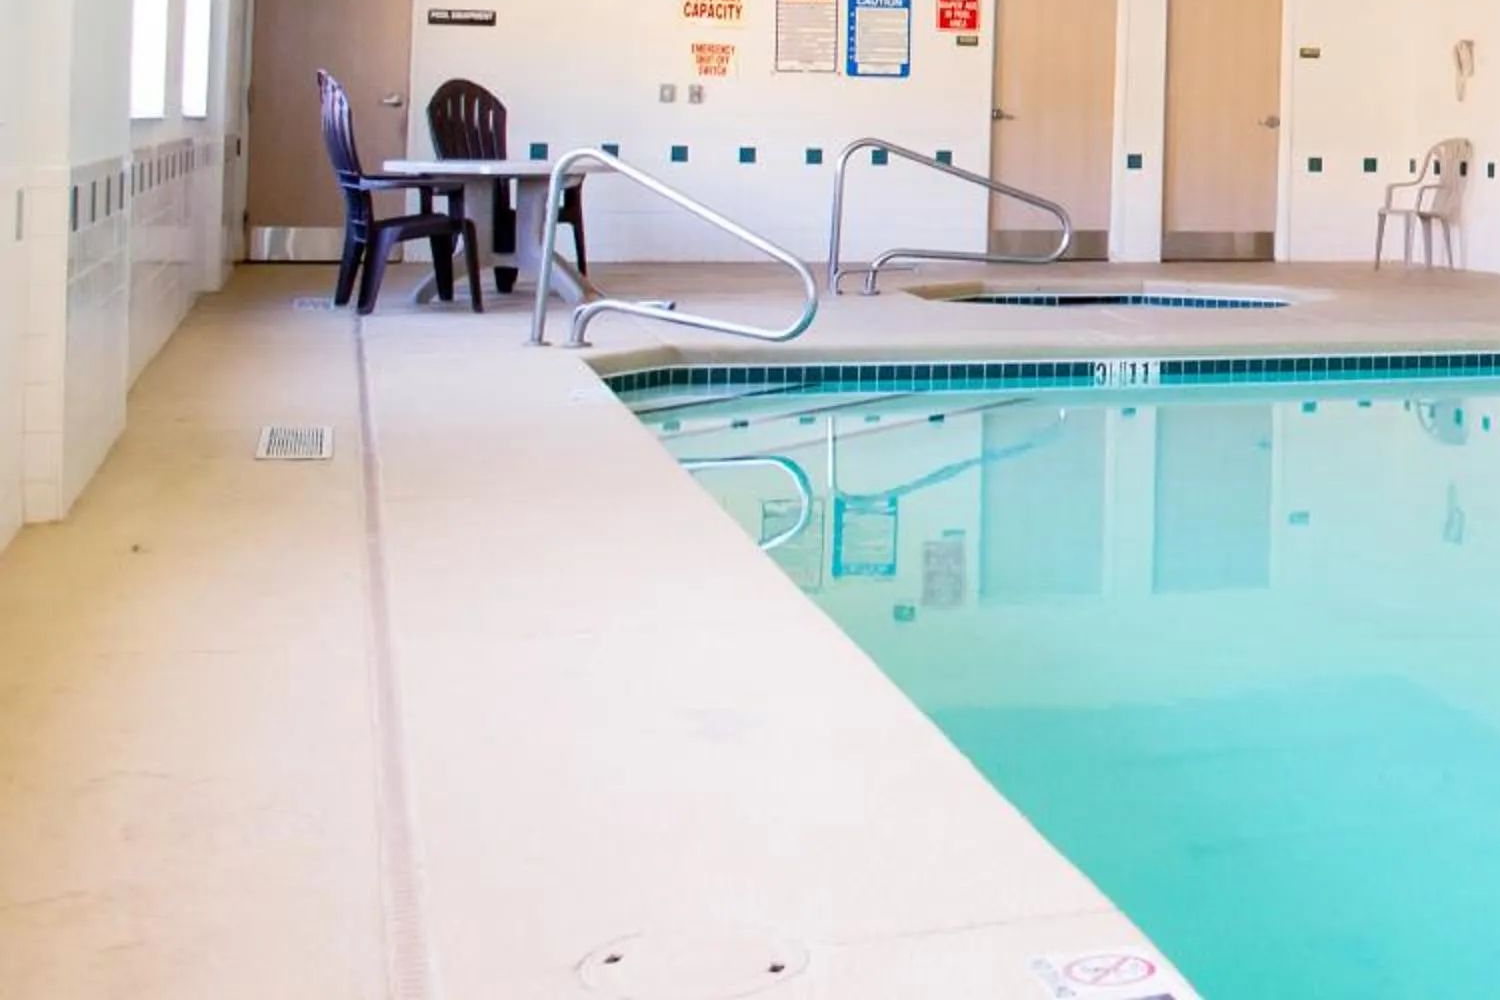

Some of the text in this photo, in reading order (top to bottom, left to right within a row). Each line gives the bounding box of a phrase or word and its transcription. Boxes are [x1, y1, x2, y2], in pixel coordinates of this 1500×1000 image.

[683, 1, 742, 20] CAPACITY
[691, 43, 736, 55] EMERGENCY
[698, 65, 727, 77] SWITCH
